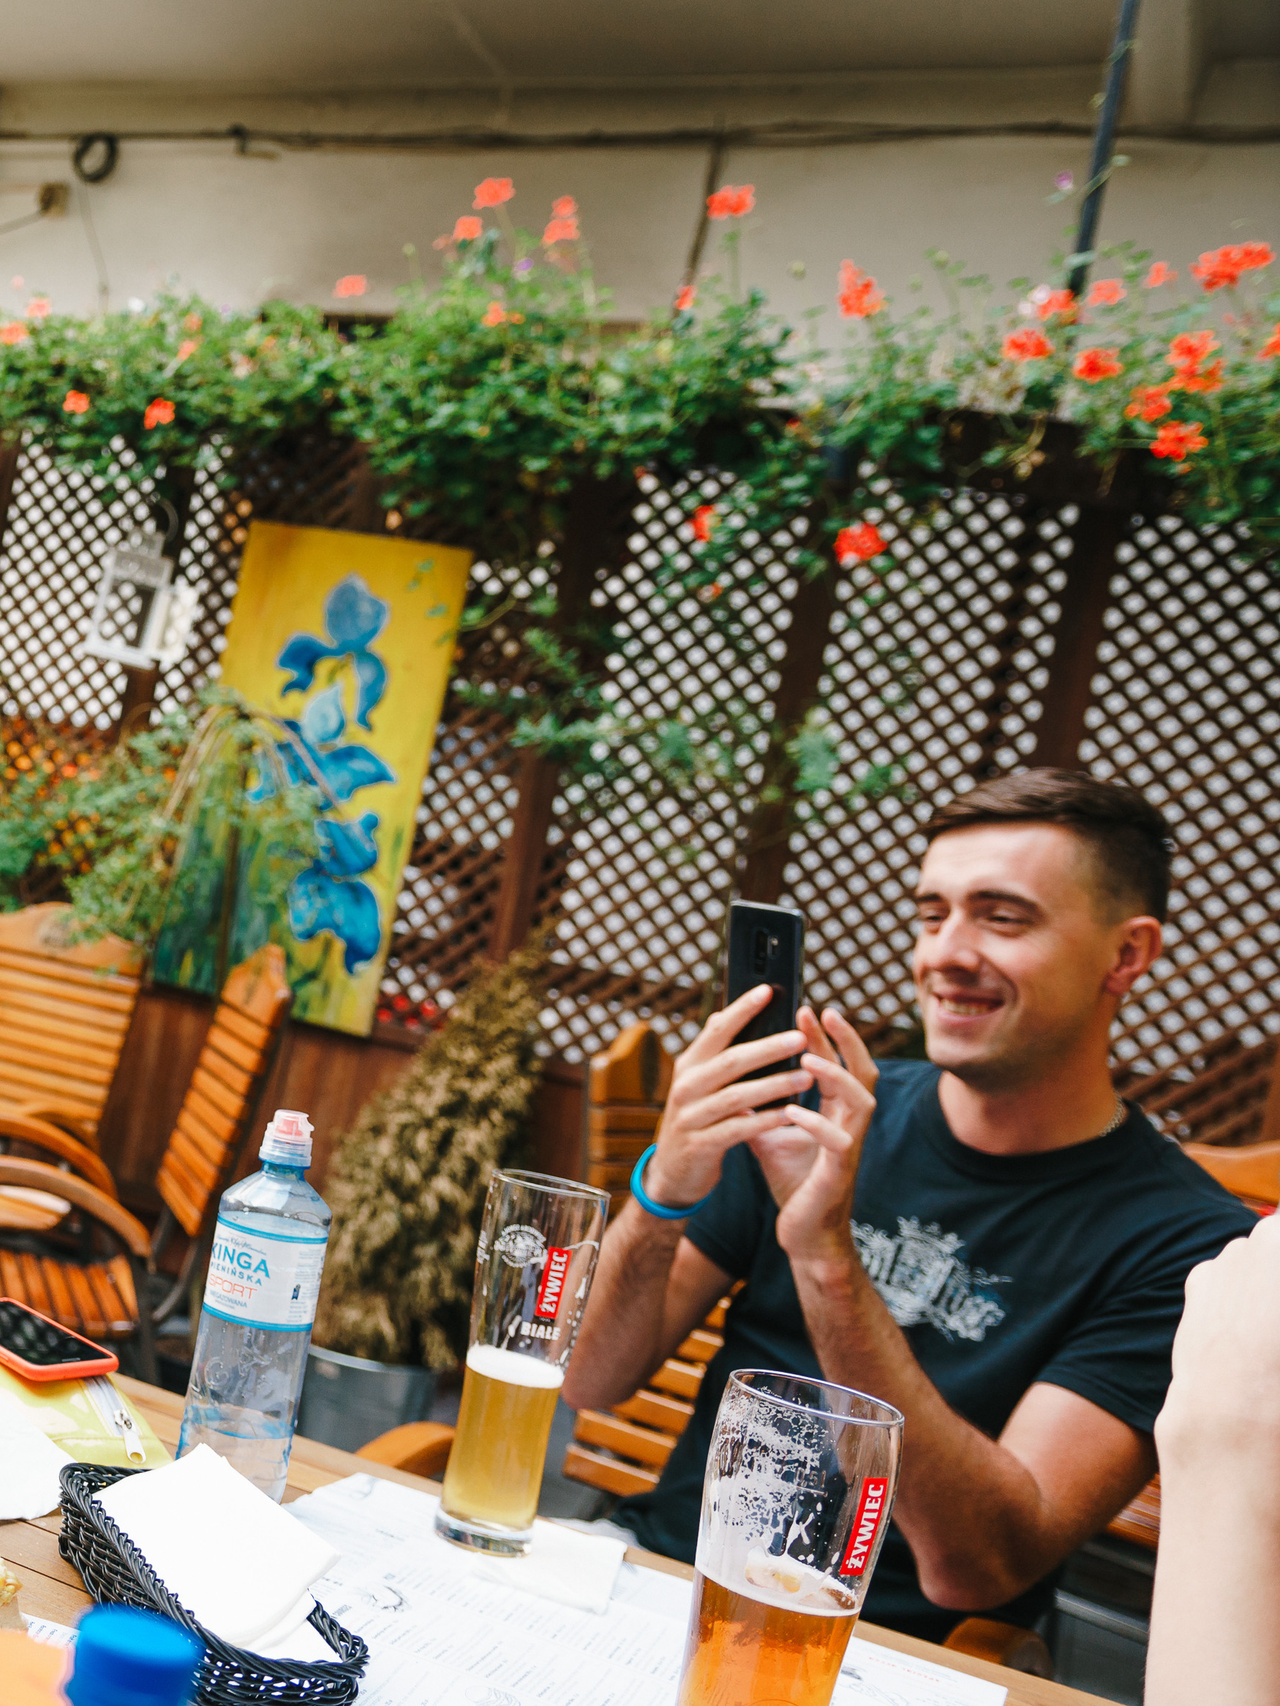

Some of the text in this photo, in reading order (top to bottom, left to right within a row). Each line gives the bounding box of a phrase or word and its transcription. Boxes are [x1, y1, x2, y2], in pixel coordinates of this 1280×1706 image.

[208, 1273, 258, 1299] SPORT
[539, 1252, 568, 1314] ŻYWIEC
[520, 1321, 561, 1340] BIAŁE
[845, 1484, 884, 1569] ŻYWIEC
